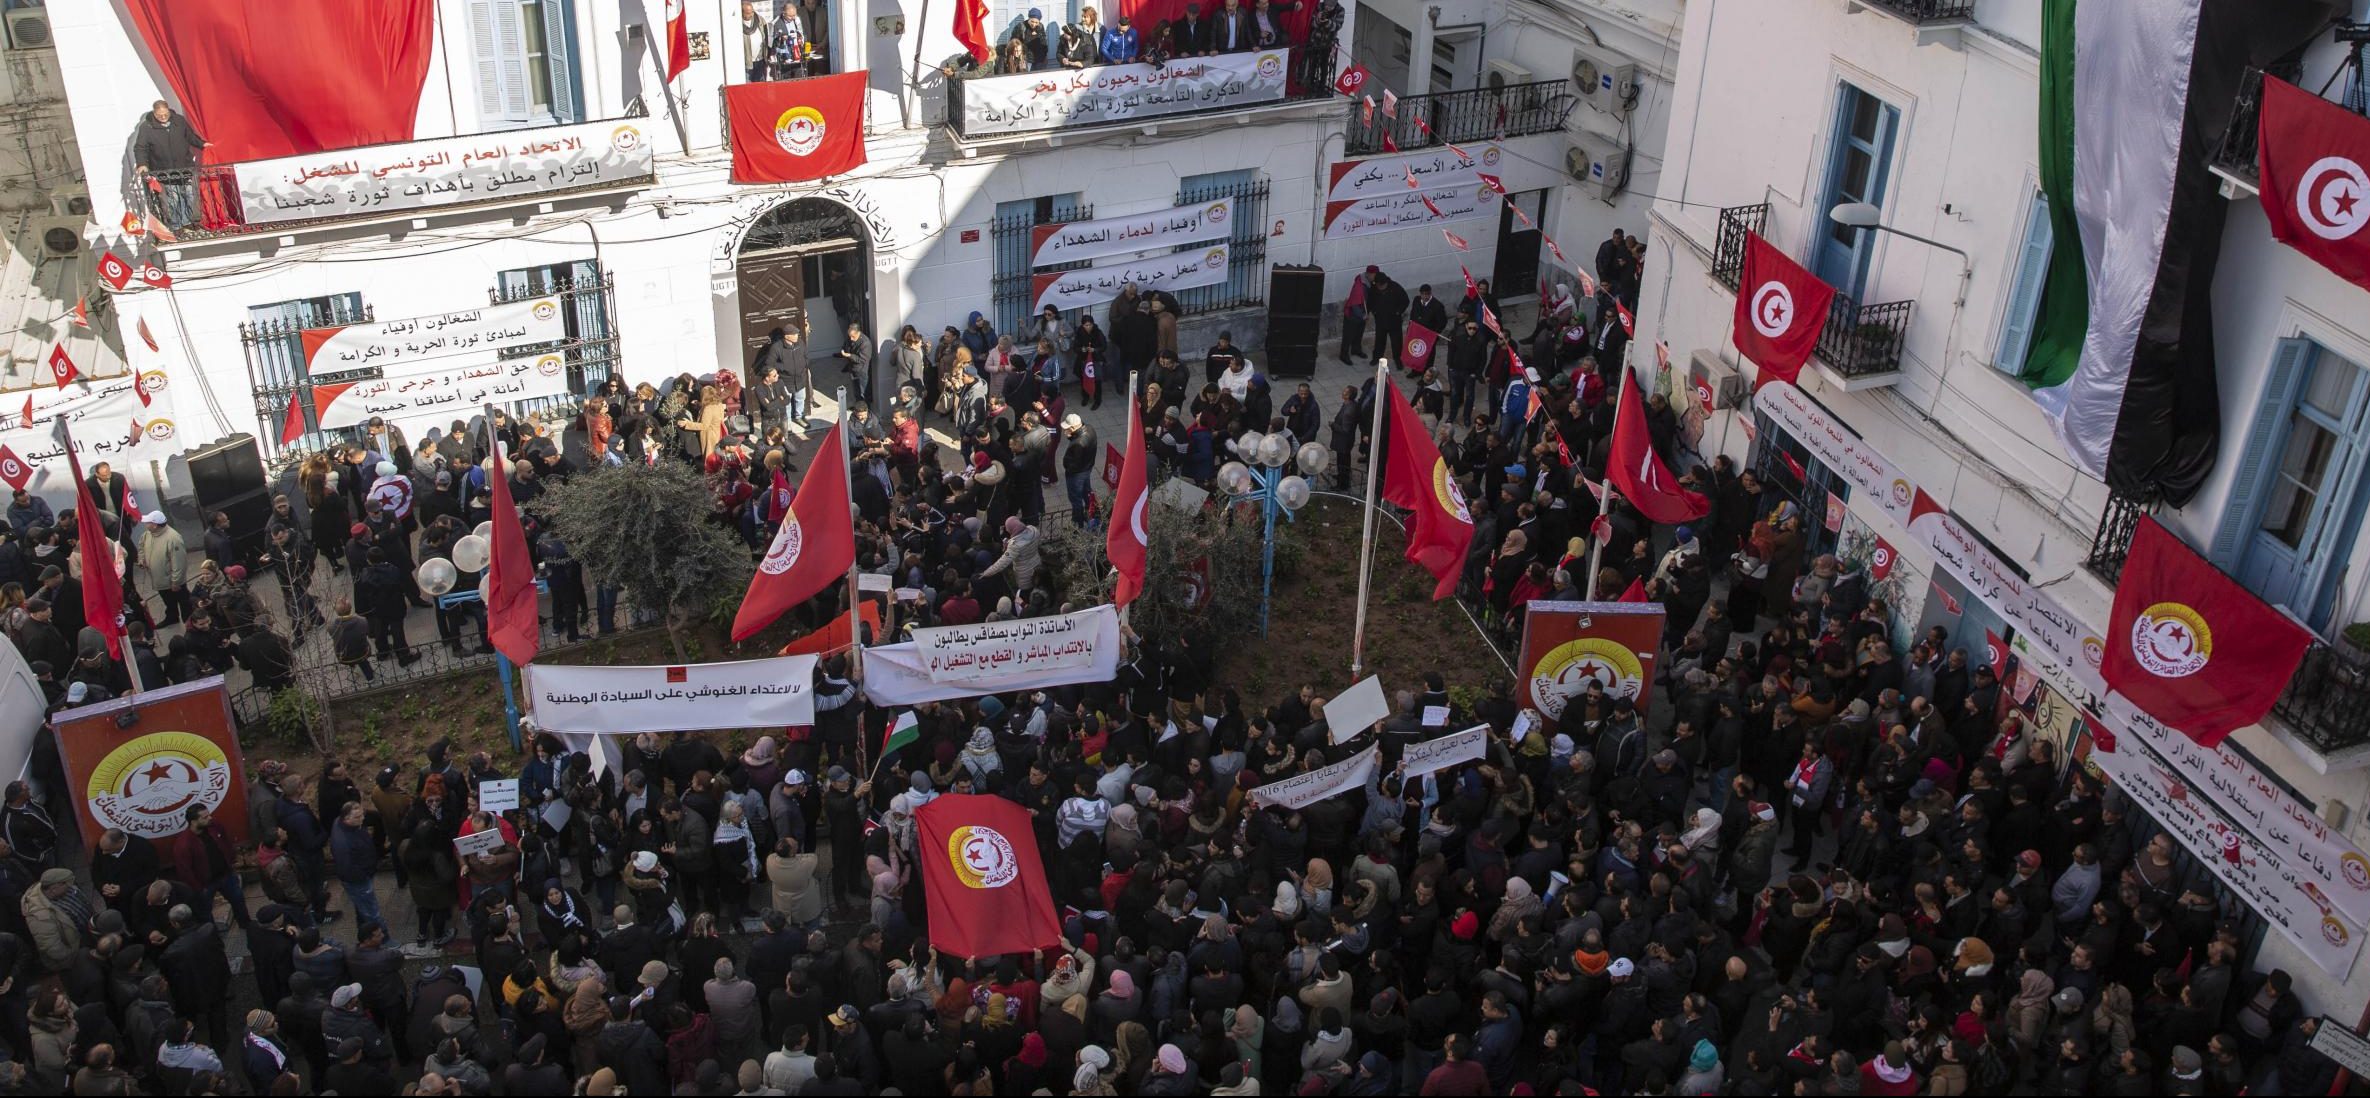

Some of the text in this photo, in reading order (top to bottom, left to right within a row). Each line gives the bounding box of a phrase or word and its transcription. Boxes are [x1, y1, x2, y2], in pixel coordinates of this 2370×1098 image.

[1031, 64, 1205, 99] الشغالون يحيون بكل فخر
[984, 81, 1245, 127] الذكرى التاسعة لثورة الحرية و الكرامة
[462, 146, 508, 168] العام
[519, 136, 582, 156] الاتحاد
[372, 151, 450, 181] التونسي
[1354, 167, 1383, 190] يكفي
[274, 161, 600, 210] إلتزام مطلق بأهداف ثورة شعبنا
[1053, 209, 1202, 251] أوفياء لدماء الشهداء
[875, 257, 898, 267] UGTT
[712, 280, 736, 291] UGTT
[1057, 262, 1199, 295] شغل حرية كرامة وطنية
[381, 311, 482, 336] الشغالون أوفياء
[339, 326, 526, 363] لمبادئ ثورة الحرية و الكرامة
[353, 363, 530, 398] حق الشهداء و جرحى الثورة
[365, 379, 526, 416] أمانة في أعناقنا جميعا
[26, 434, 141, 467] حريم الطبيع
[1932, 536, 1964, 571] شعبنا
[1941, 515, 2077, 639] الانتصار للسيادة الوطنية
[1968, 566, 2000, 600] كرامة
[2004, 600, 2024, 620] عن
[934, 618, 1076, 649] الأساتذة النواب بصفاقس يطالبون
[2029, 618, 2060, 653] دفاعا
[943, 652, 976, 671] التشغيل
[978, 656, 989, 670] مع
[990, 650, 1016, 669] القطع
[1023, 646, 1051, 663] المباشر
[546, 691, 598, 705] الوطنية
[601, 689, 651, 704] السيادة
[655, 687, 682, 700] على
[685, 684, 747, 704] الغنوشي
[2130, 710, 2169, 743] الوطني
[2171, 742, 2205, 773] القرار
[2214, 744, 2327, 843] الاتحاد العام التون
[2178, 799, 2206, 821] مفتو
[2196, 828, 2224, 855] رجاع
[2267, 825, 2290, 845] عن
[2297, 843, 2332, 882] دفاعا
